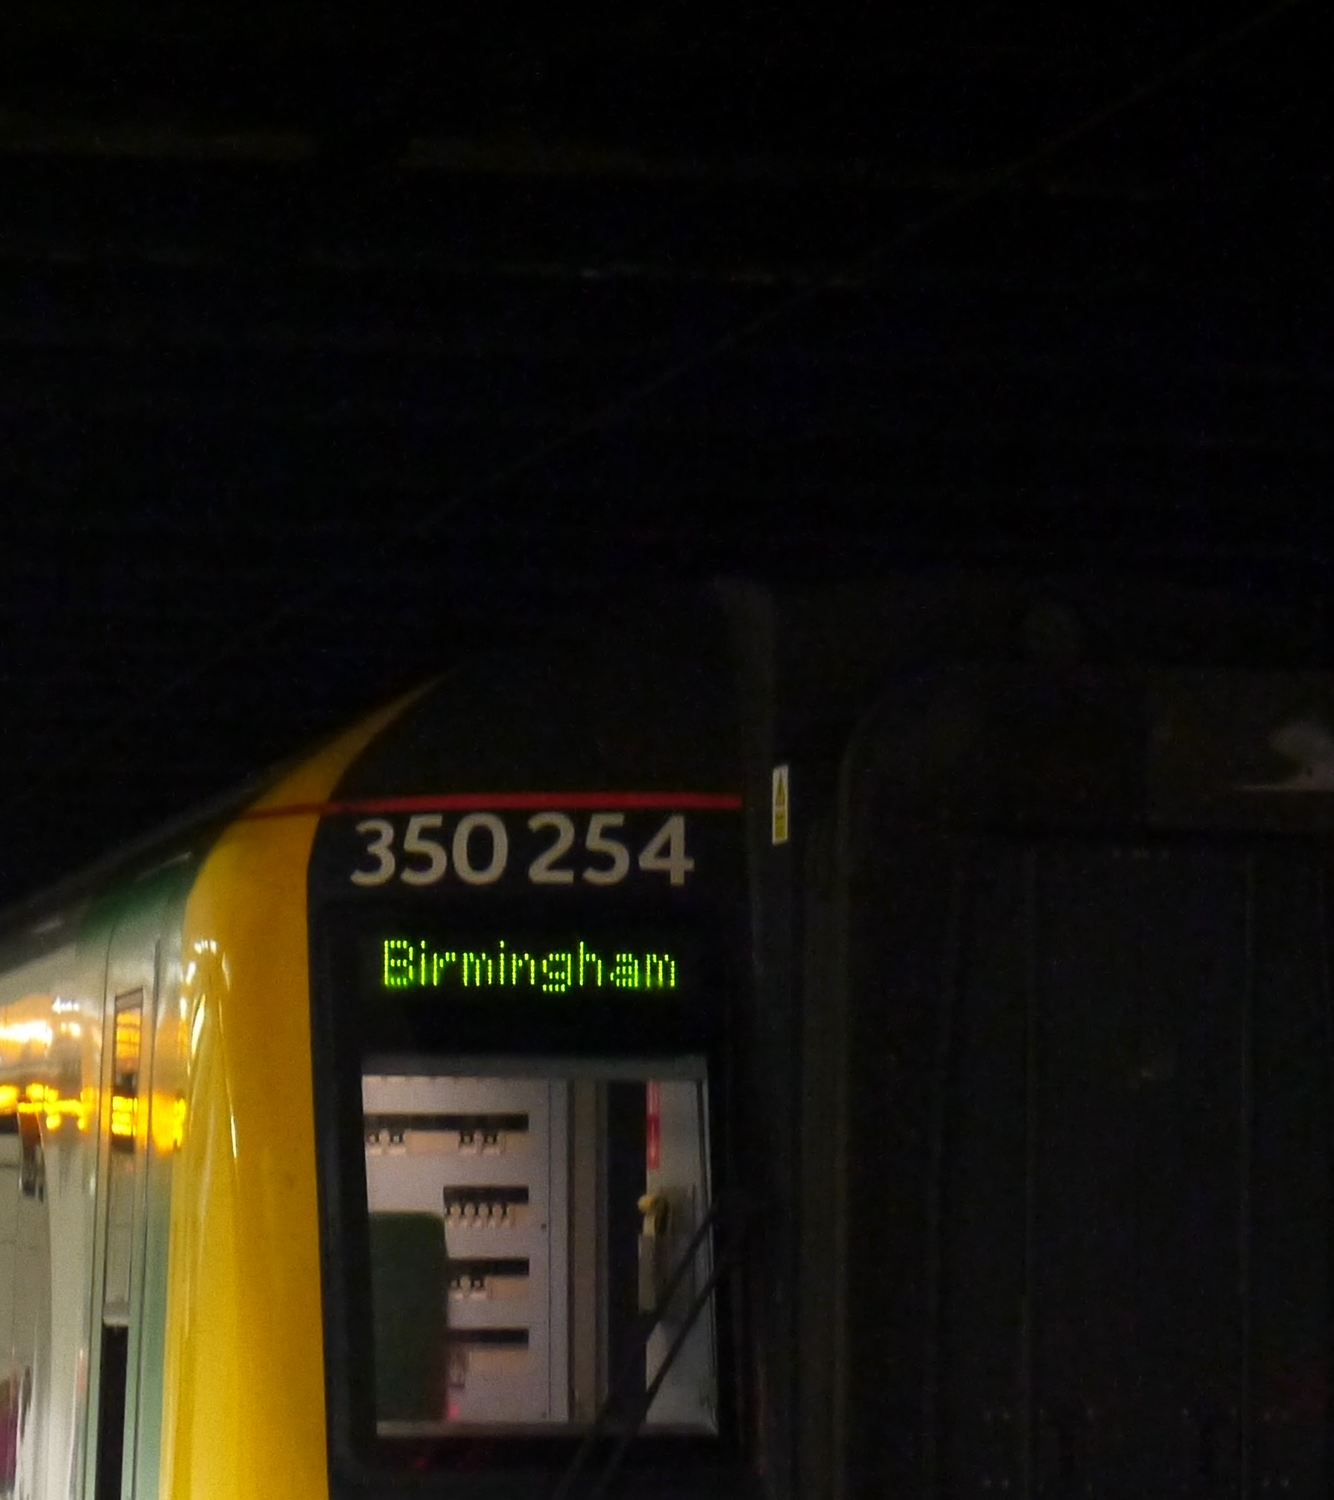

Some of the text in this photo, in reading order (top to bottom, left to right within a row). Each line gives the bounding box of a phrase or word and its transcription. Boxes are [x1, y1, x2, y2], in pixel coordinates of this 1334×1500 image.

[350, 813, 695, 887] 350 254
[383, 940, 677, 992] Birmingham
